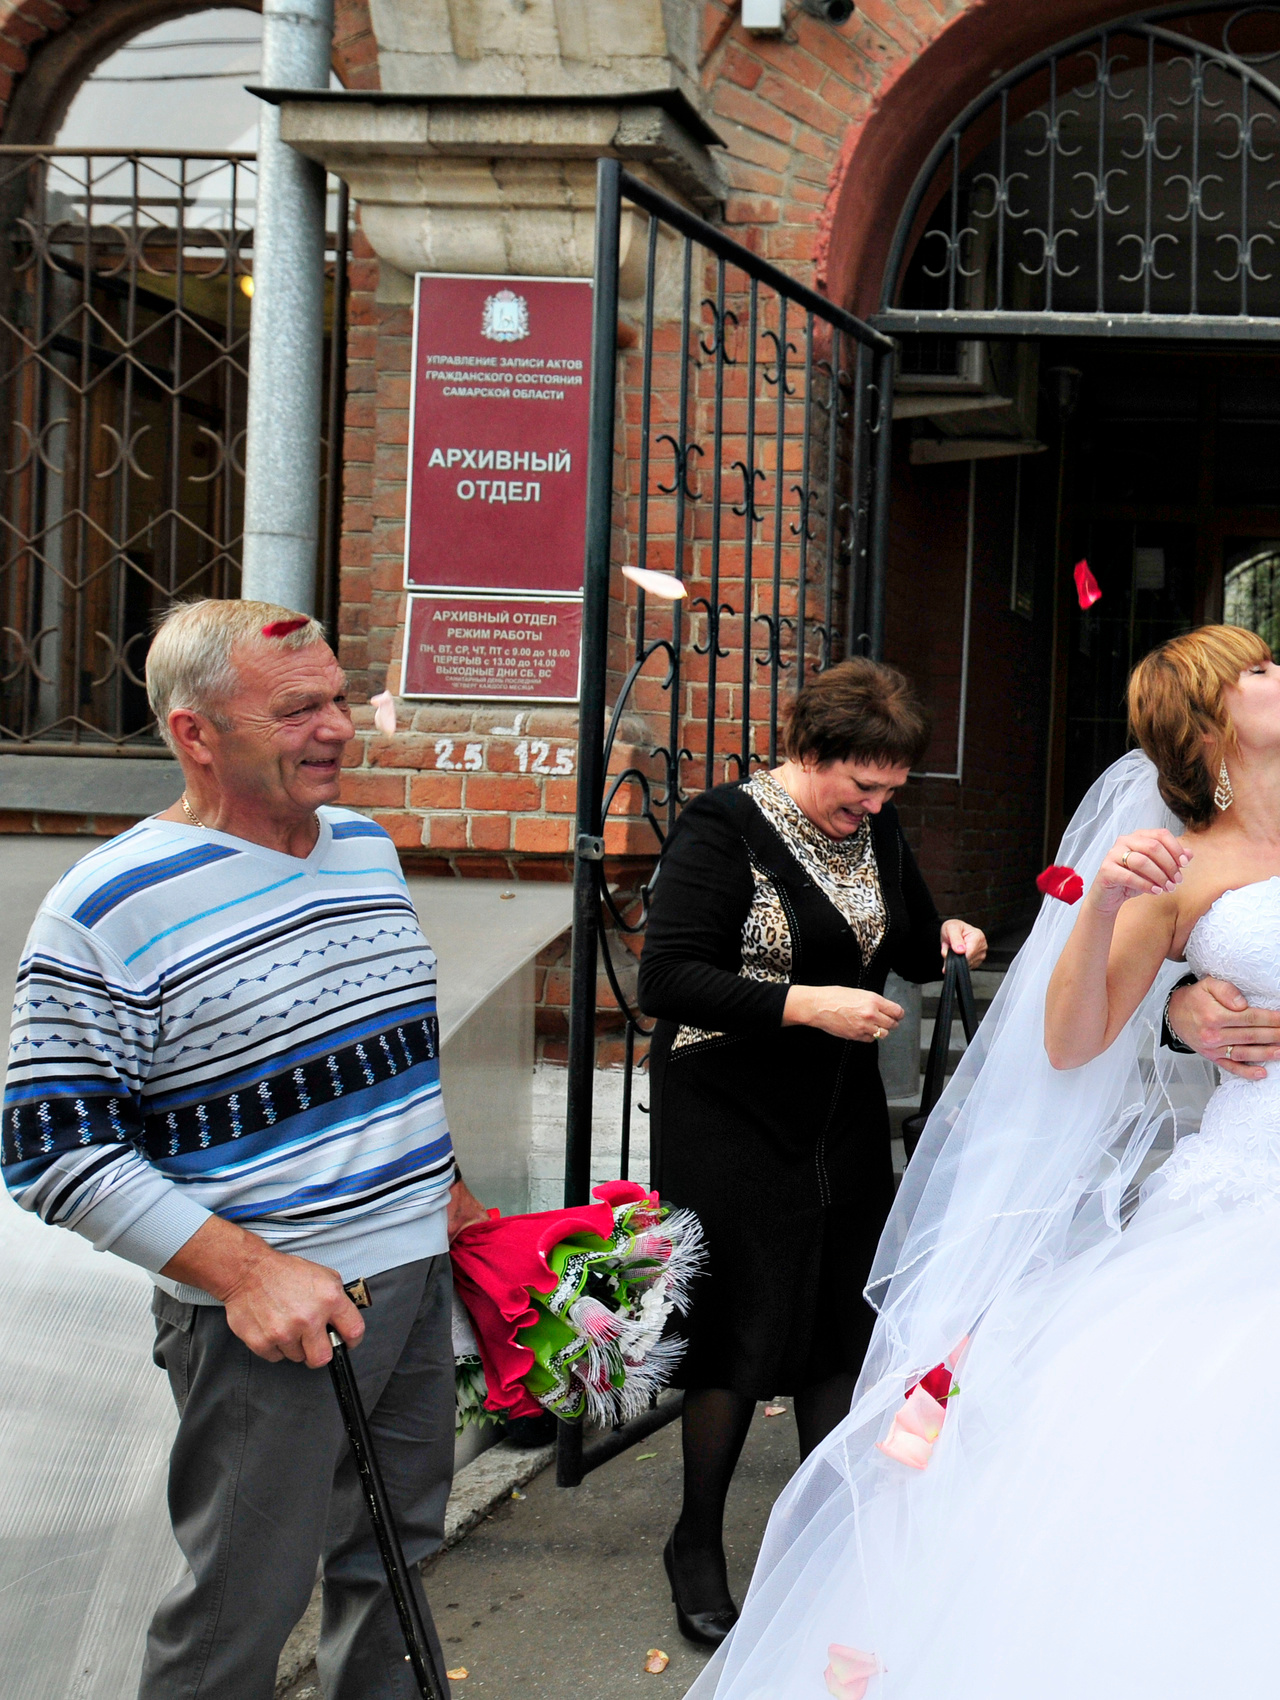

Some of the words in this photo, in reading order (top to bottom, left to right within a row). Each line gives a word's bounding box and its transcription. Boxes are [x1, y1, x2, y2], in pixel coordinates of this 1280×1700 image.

[426, 355, 497, 366] УПРАВЛЕНИЕ
[500, 357, 544, 368] ЗАПИСИ
[546, 359, 583, 370] АКТОВ
[426, 370, 513, 383] ГРАЖДАНСКОГО
[515, 373, 583, 385] СОСТОЯНИЯ
[442, 386, 510, 398] САМАРСКОЙ
[512, 389, 564, 400] ОБЛАСТИ
[428, 448, 571, 472] АРХИВНЫЙ
[456, 480, 540, 504] ОТДЕЛ
[432, 610, 509, 624] АРХИВНЫЙ
[513, 613, 557, 626] ОТДЕЛ
[447, 628, 490, 639] РЕЖИМ
[494, 630, 542, 641] РАБОТЫ
[489, 646, 502, 655] ПТ
[512, 648, 531, 656] 9.00
[532, 650, 545, 658] до
[548, 649, 570, 658] 18.00
[433, 655, 482, 665] ПЕРЕРЫВ
[493, 657, 516, 666] 13.00
[517, 660, 530, 668] до
[533, 659, 556, 668] 14.00
[436, 666, 494, 676] ВЫХОДНЫЕ
[496, 668, 518, 677] ДНИ
[538, 670, 552, 678] ВС
[434, 738, 483, 771] 2.5
